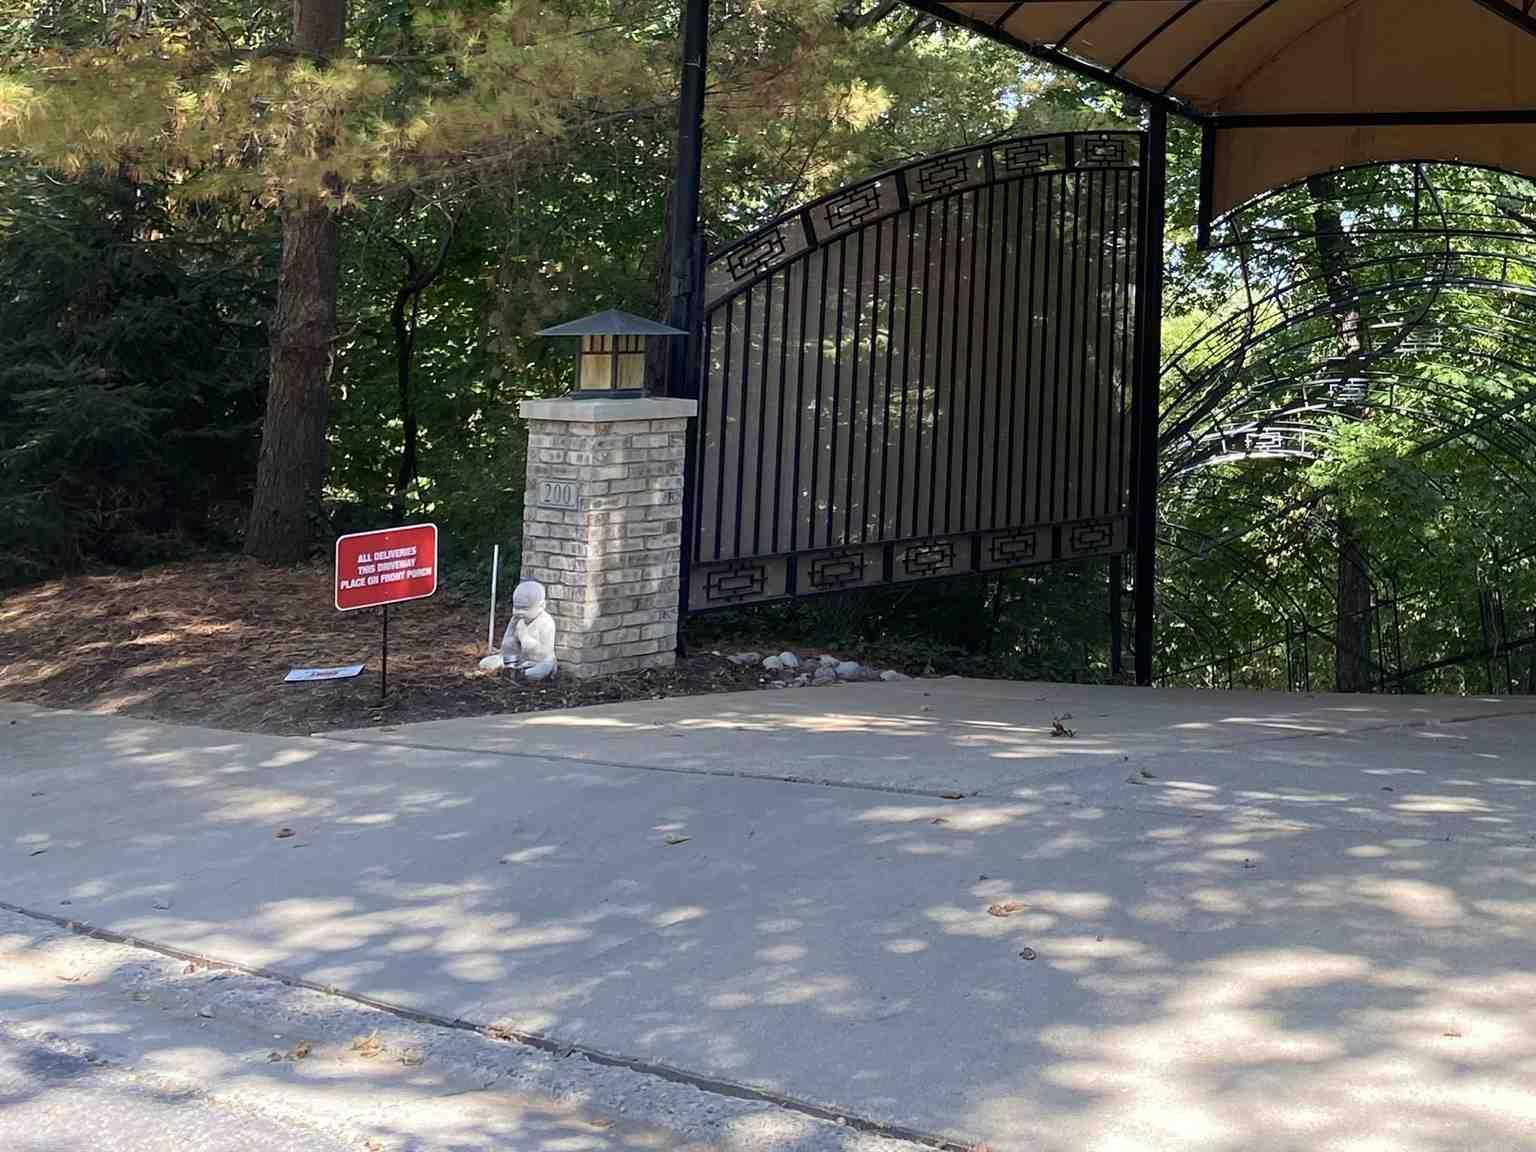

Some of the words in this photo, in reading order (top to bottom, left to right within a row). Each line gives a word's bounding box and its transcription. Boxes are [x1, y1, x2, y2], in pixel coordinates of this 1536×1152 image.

[544, 482, 571, 504] 200
[357, 553, 372, 563] ALL
[374, 546, 417, 561] DELIVERIES
[357, 564, 375, 575] THIS
[377, 558, 417, 573] DRIVEWAY
[340, 577, 366, 590] PLACE
[367, 575, 379, 585] ON
[380, 570, 405, 584] FRONT
[406, 566, 433, 580] PORCH
